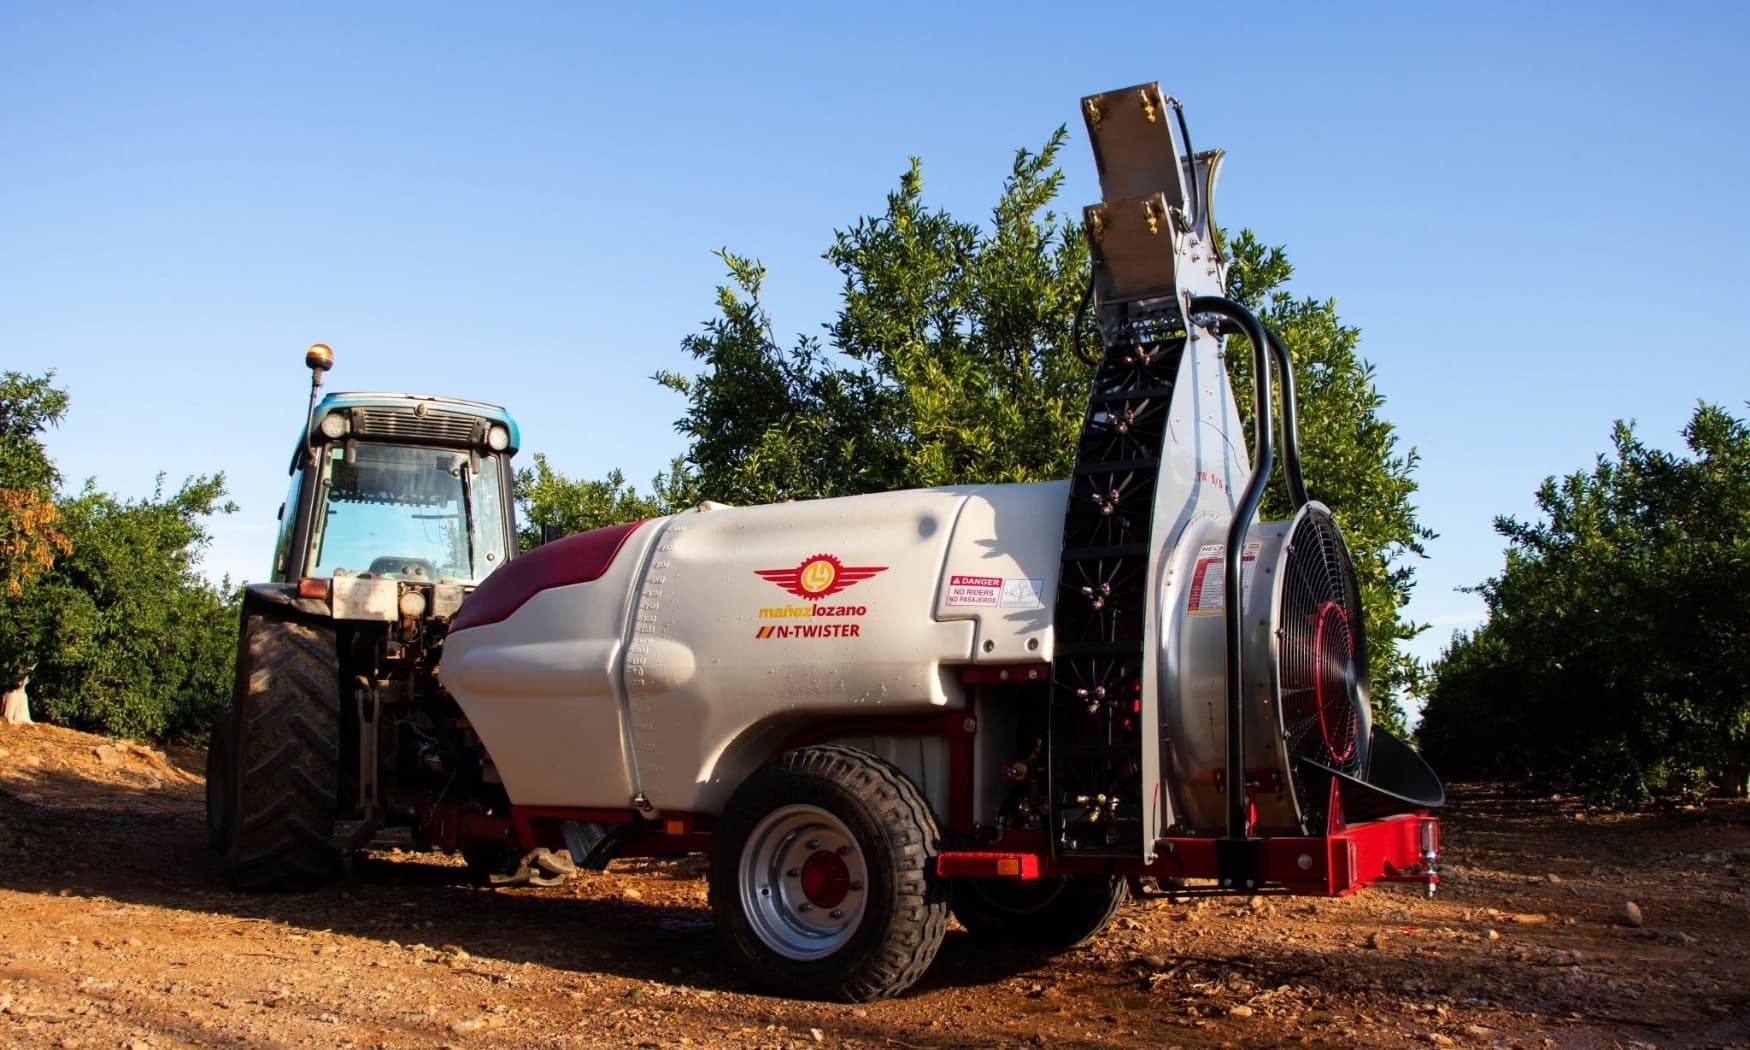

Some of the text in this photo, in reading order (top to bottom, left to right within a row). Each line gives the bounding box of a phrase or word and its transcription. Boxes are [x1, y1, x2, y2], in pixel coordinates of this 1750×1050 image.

[962, 577, 1000, 586] DANGER
[953, 588, 994, 597] NO RIDERS
[948, 595, 959, 603] NO
[959, 596, 997, 604] PASAJEROS
[776, 624, 860, 639] N-TWISTER
